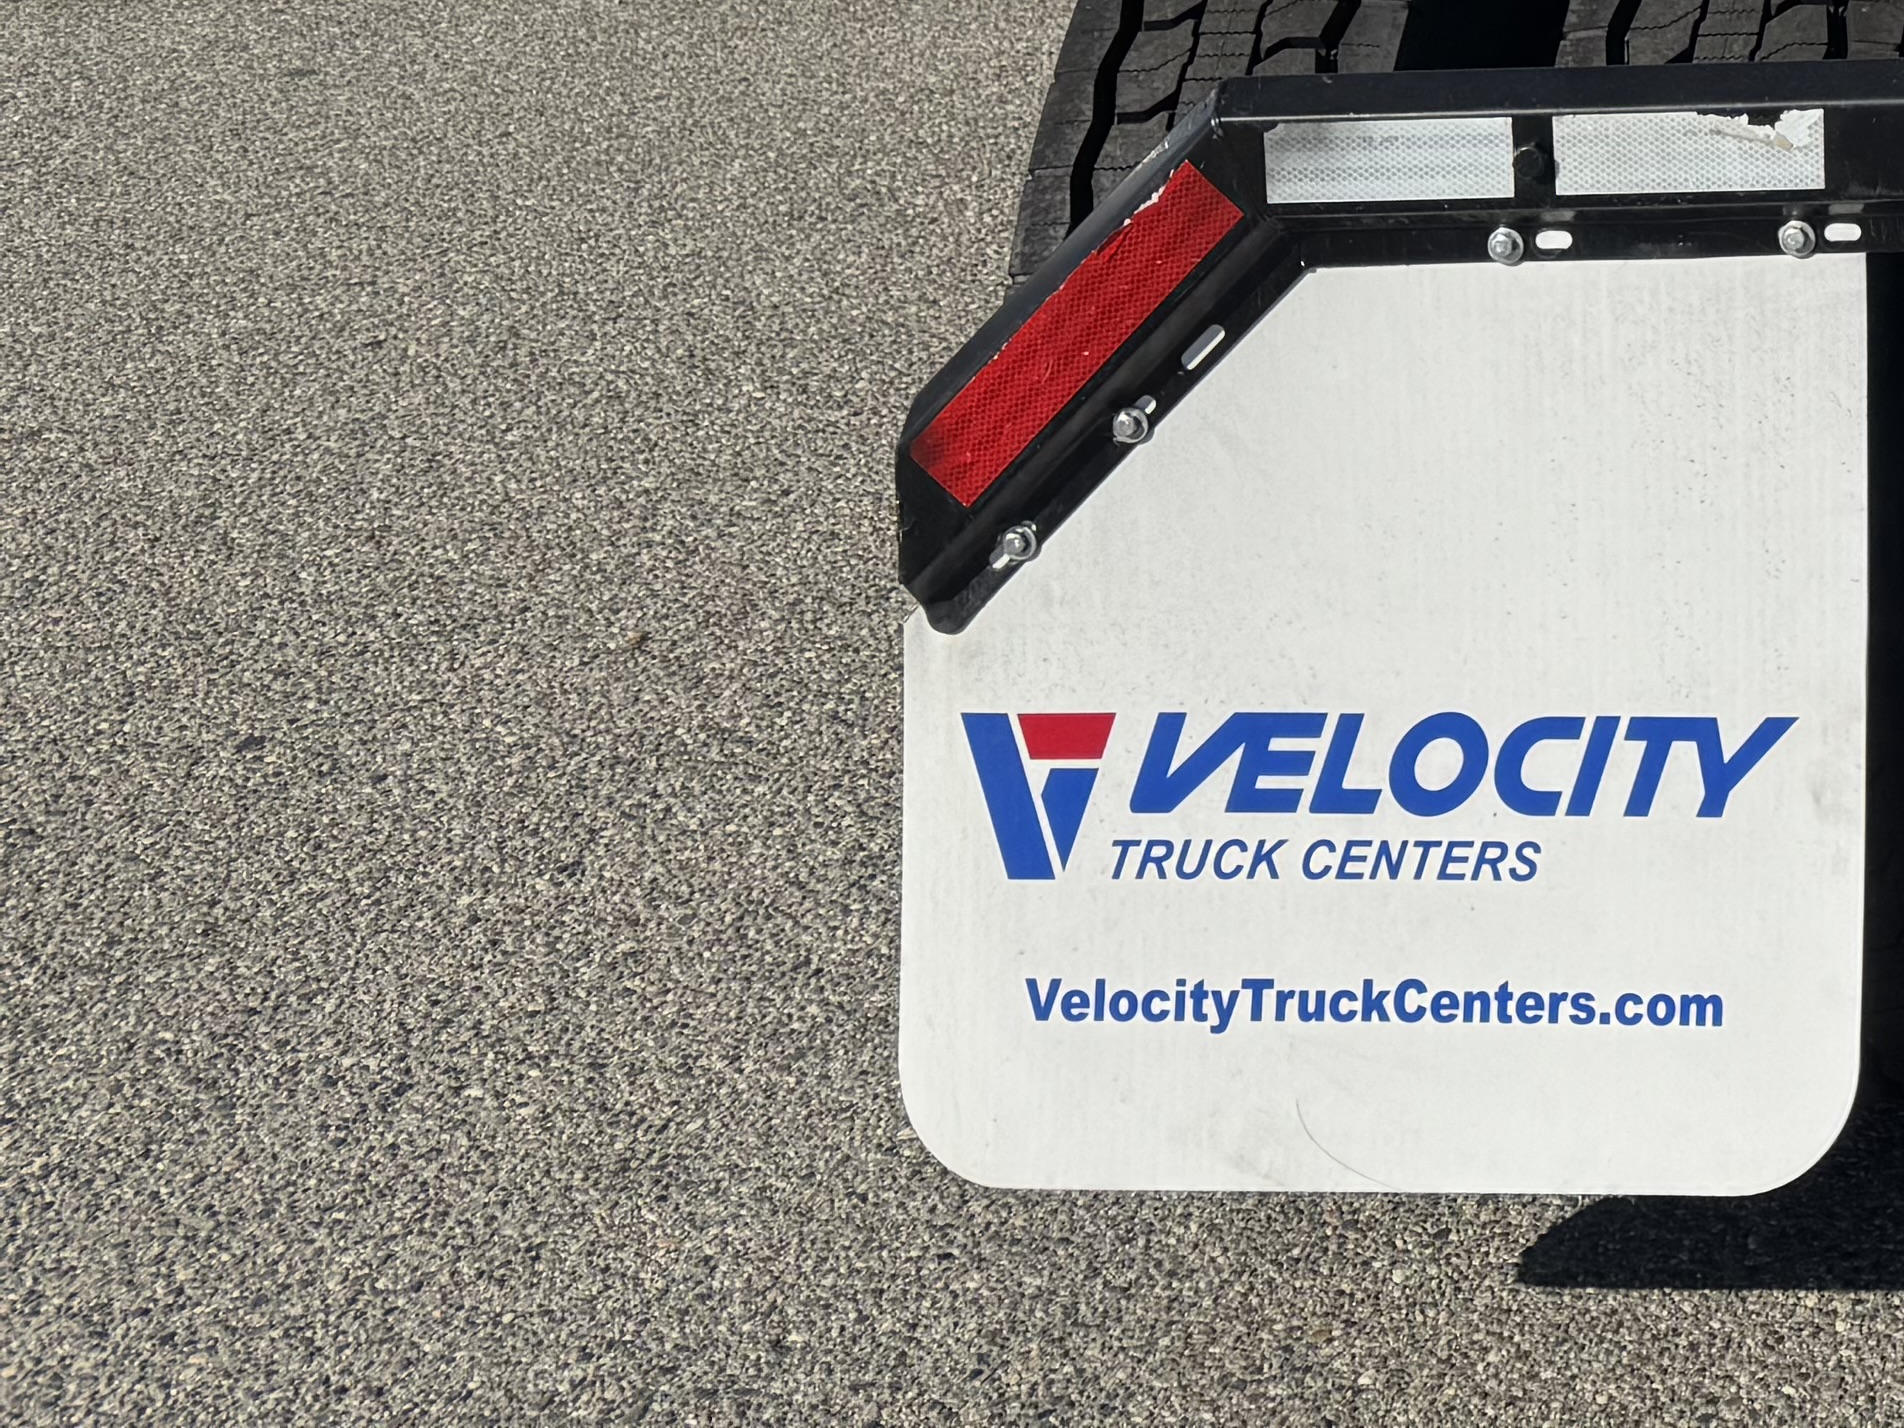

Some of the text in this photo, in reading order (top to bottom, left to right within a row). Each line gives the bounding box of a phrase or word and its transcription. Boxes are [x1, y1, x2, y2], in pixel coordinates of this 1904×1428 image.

[1130, 712, 1798, 817] VELOCITY
[1113, 839, 1542, 882] TRUCK CENTERS
[1026, 977, 1724, 1034] VelocityTruckCenters.com
